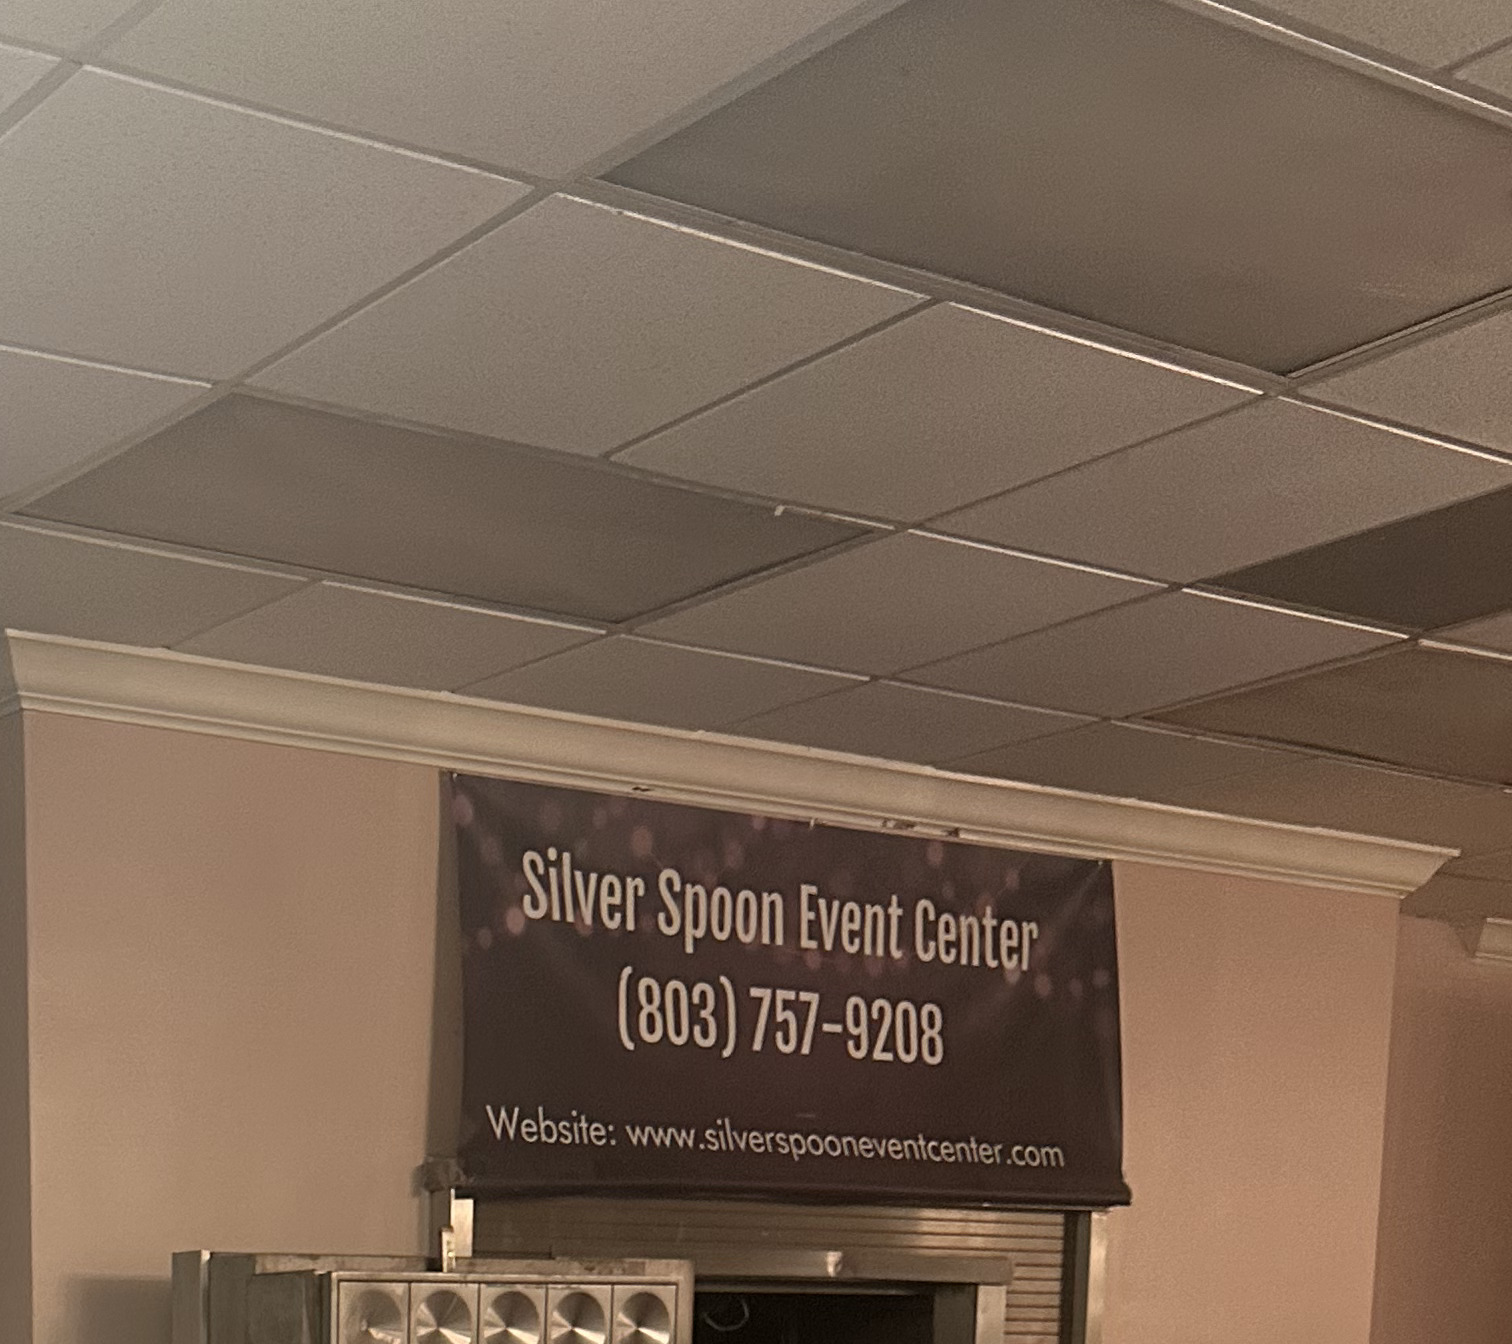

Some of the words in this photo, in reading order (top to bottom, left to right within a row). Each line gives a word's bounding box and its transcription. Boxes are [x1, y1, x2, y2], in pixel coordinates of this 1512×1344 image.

[522, 847, 645, 931] Silver
[657, 868, 783, 954] Spoon
[800, 883, 903, 960] Event
[915, 899, 1038, 971] Center
[618, 966, 736, 1058] (803)
[749, 987, 944, 1066] 757-9208
[486, 1104, 617, 1147] Website:
[624, 1118, 1064, 1169] www.silverspooneventcenter.com
